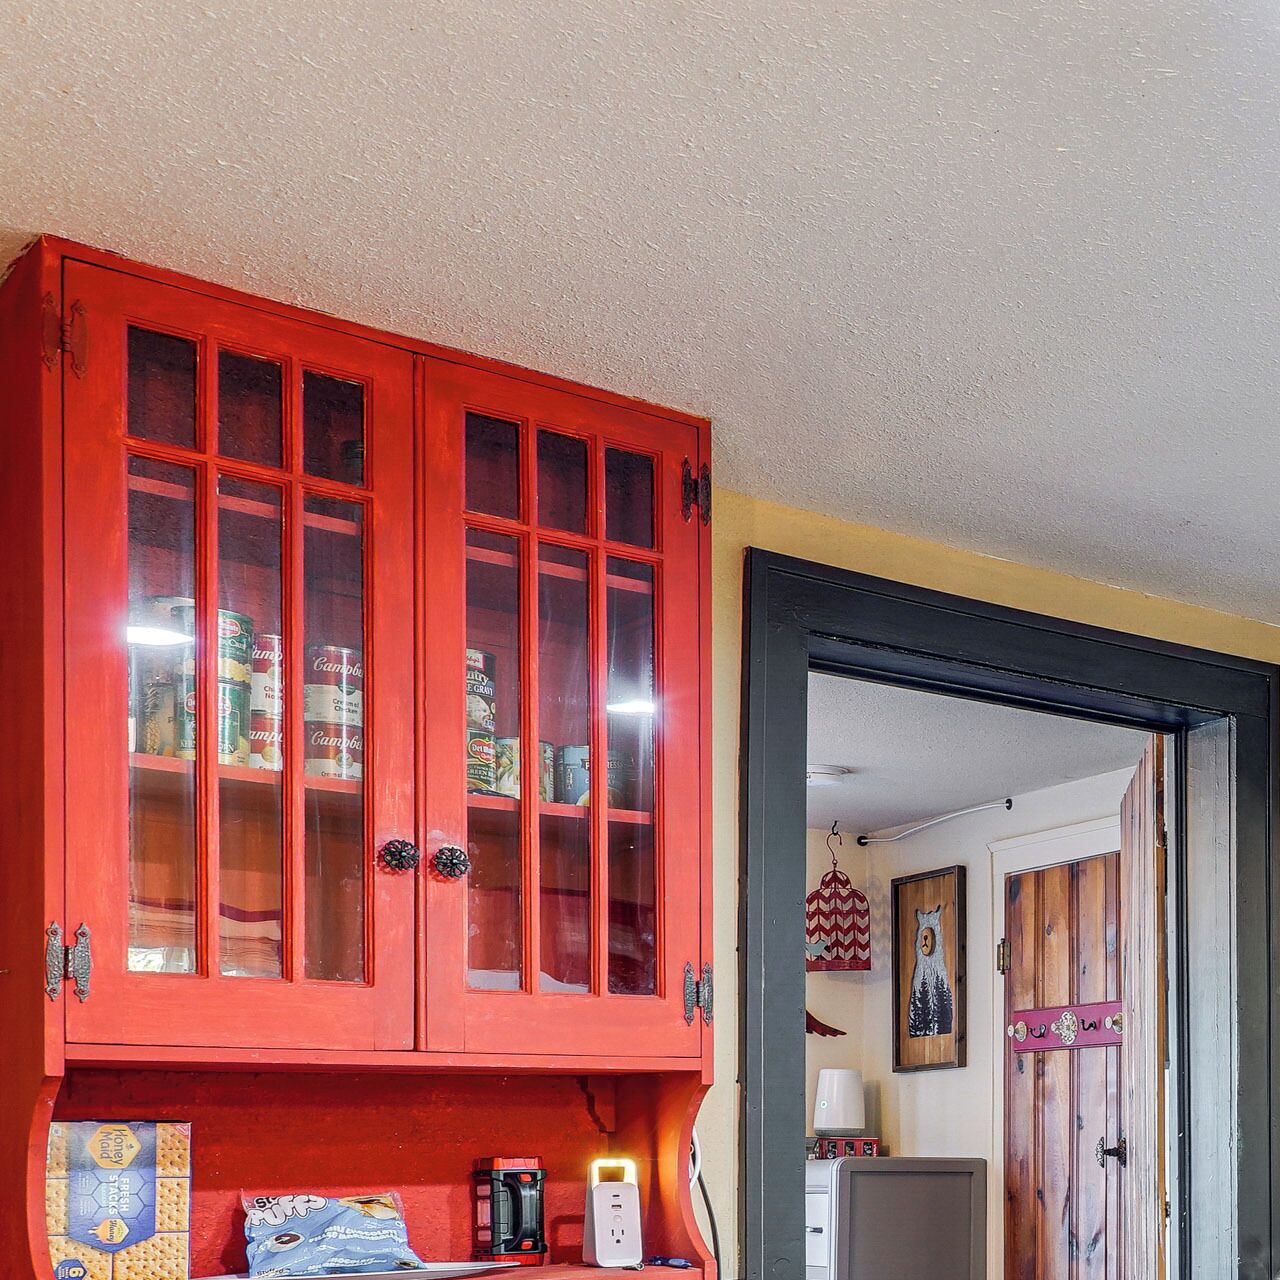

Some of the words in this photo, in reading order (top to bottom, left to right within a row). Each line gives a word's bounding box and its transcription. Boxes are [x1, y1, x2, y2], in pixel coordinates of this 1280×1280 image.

[100, 1131, 110, 1160] Maid
[112, 1128, 127, 1166] Honey
[108, 1175, 118, 1215] STACKS
[119, 1178, 130, 1212] FRESH
[108, 1219, 117, 1243] Honey
[69, 1267, 83, 1277] 6
